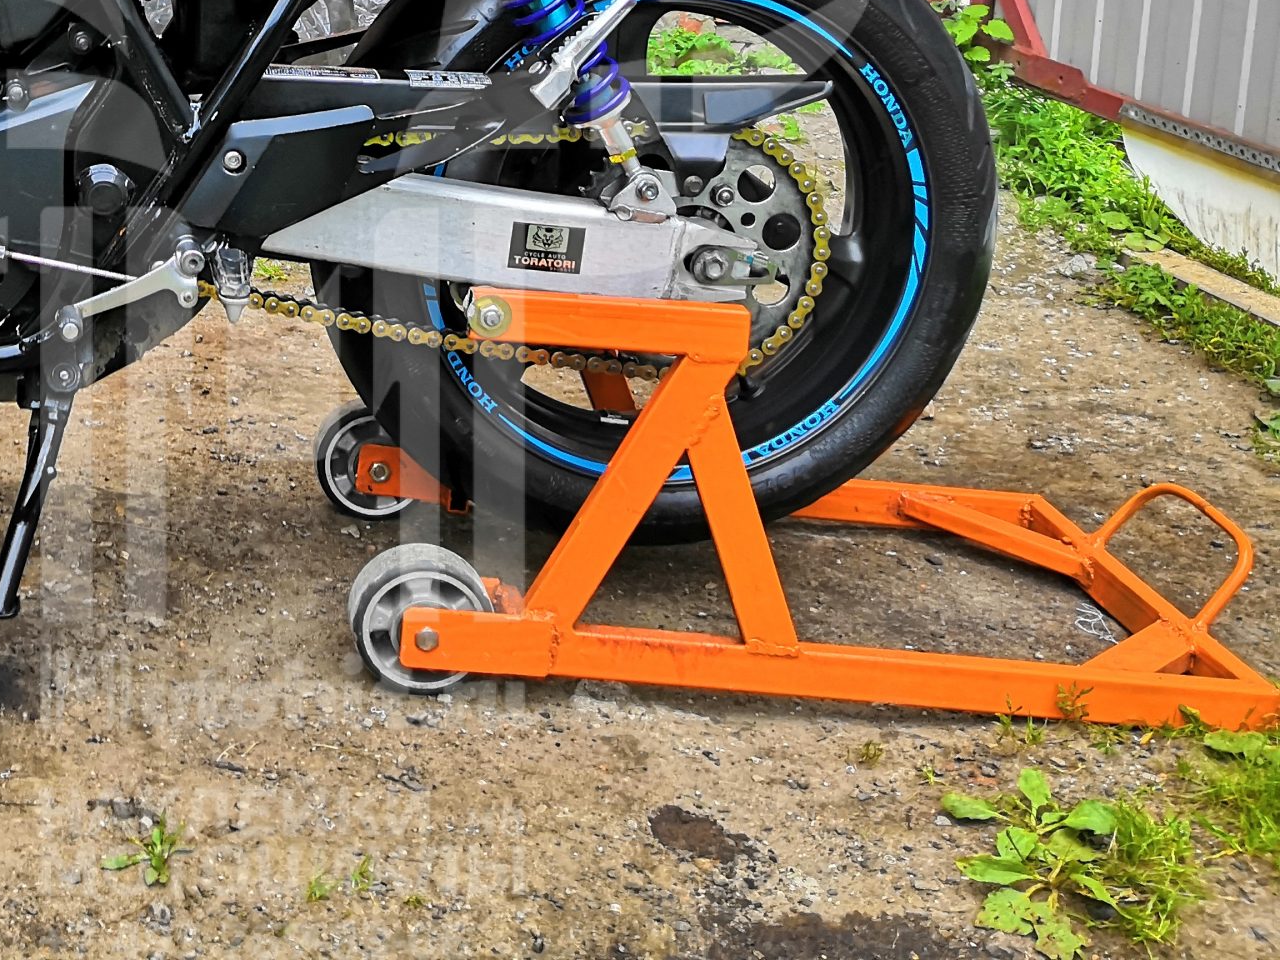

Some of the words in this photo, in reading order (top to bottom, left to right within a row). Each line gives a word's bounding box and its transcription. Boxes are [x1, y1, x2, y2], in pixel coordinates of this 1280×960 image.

[859, 63, 914, 148] HONDA
[513, 255, 576, 269] TORATORI
[442, 345, 498, 414] HOND
[755, 399, 840, 456] HONDA
